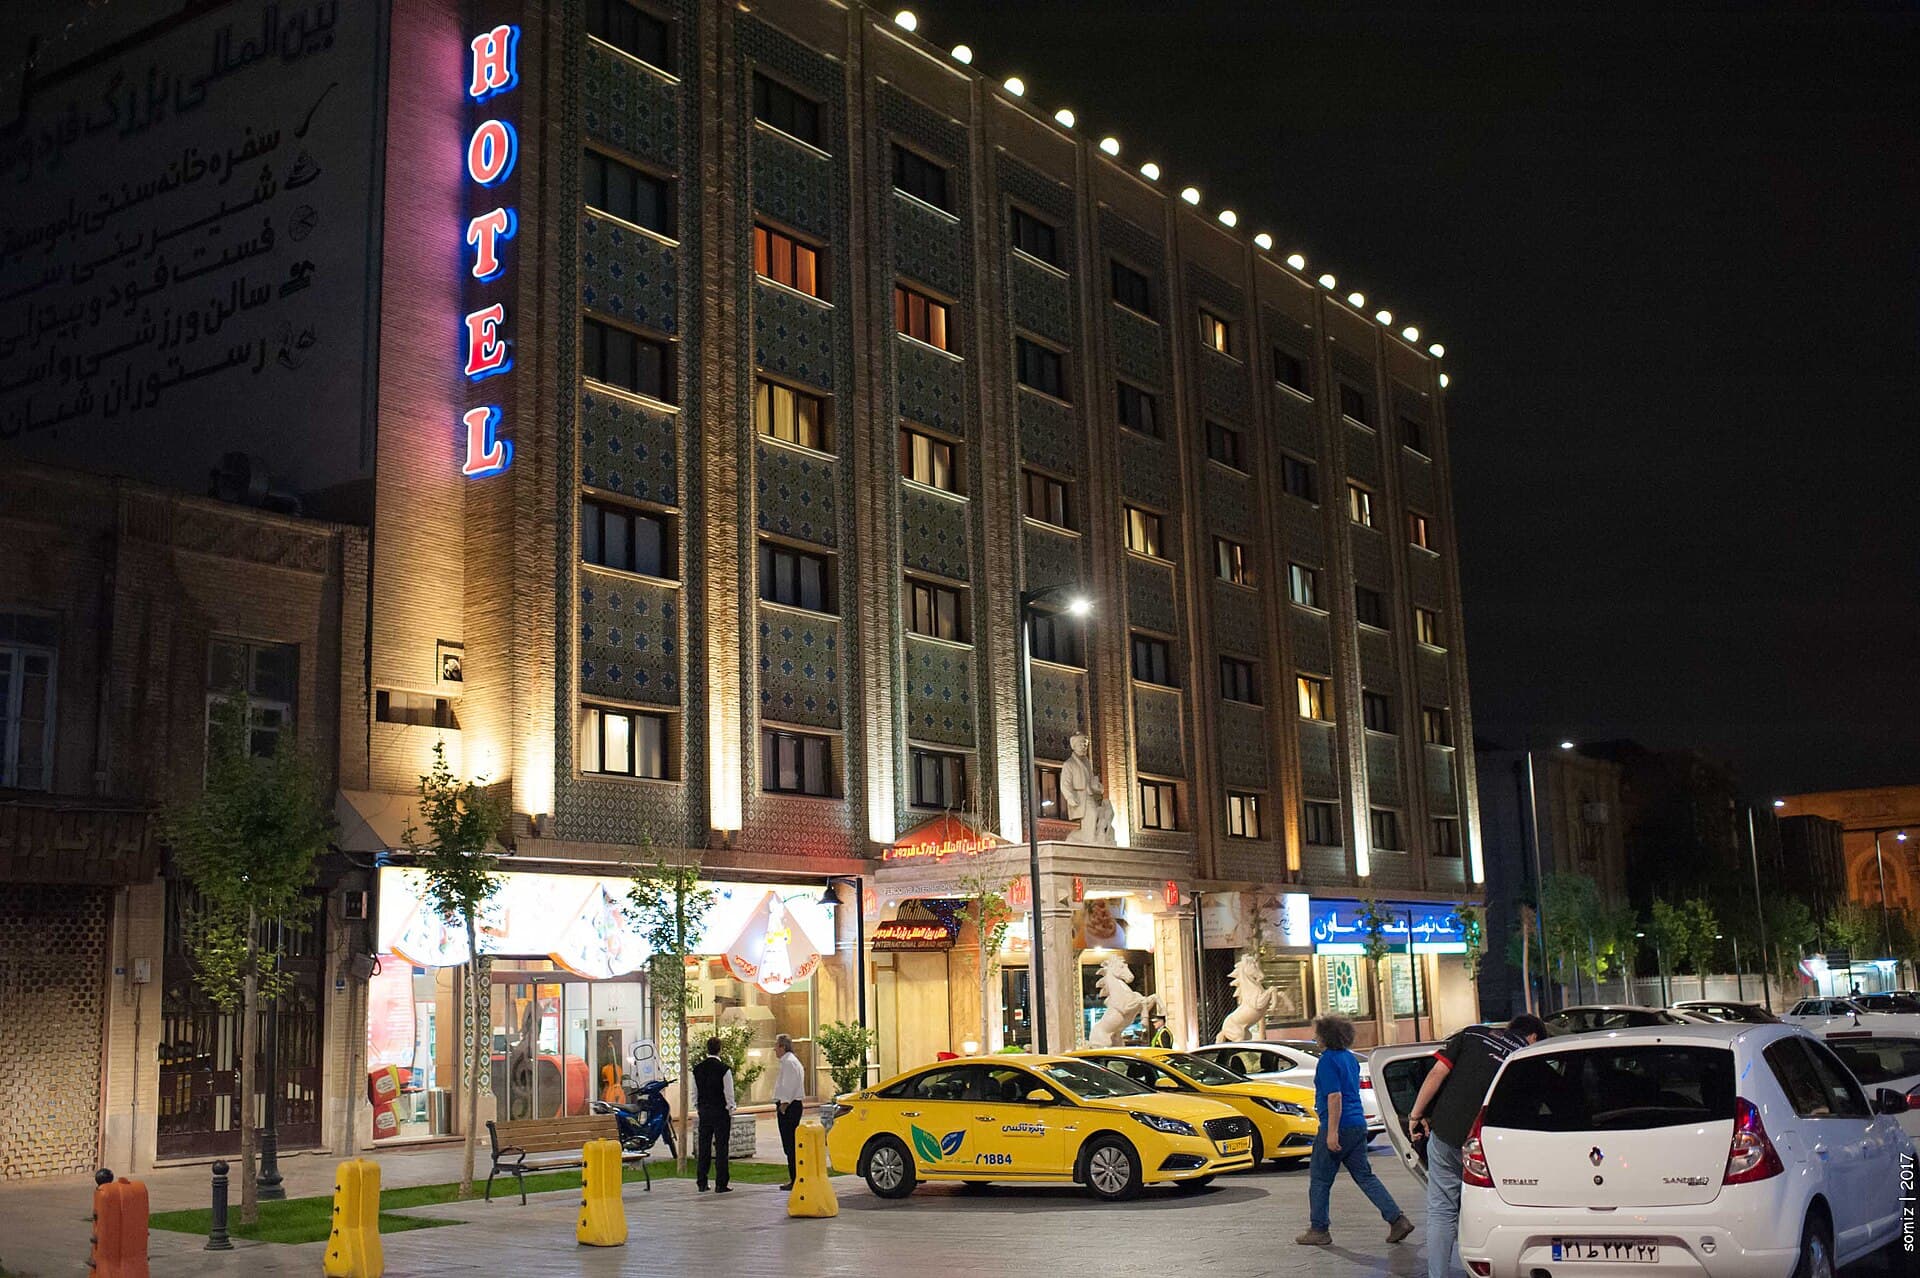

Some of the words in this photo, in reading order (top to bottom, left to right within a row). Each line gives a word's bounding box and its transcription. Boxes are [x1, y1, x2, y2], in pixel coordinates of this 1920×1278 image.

[281, 0, 337, 63] بین
[462, 24, 519, 478] HOTEL
[104, 337, 266, 419] رستوران
[984, 1154, 1013, 1165] 1884
